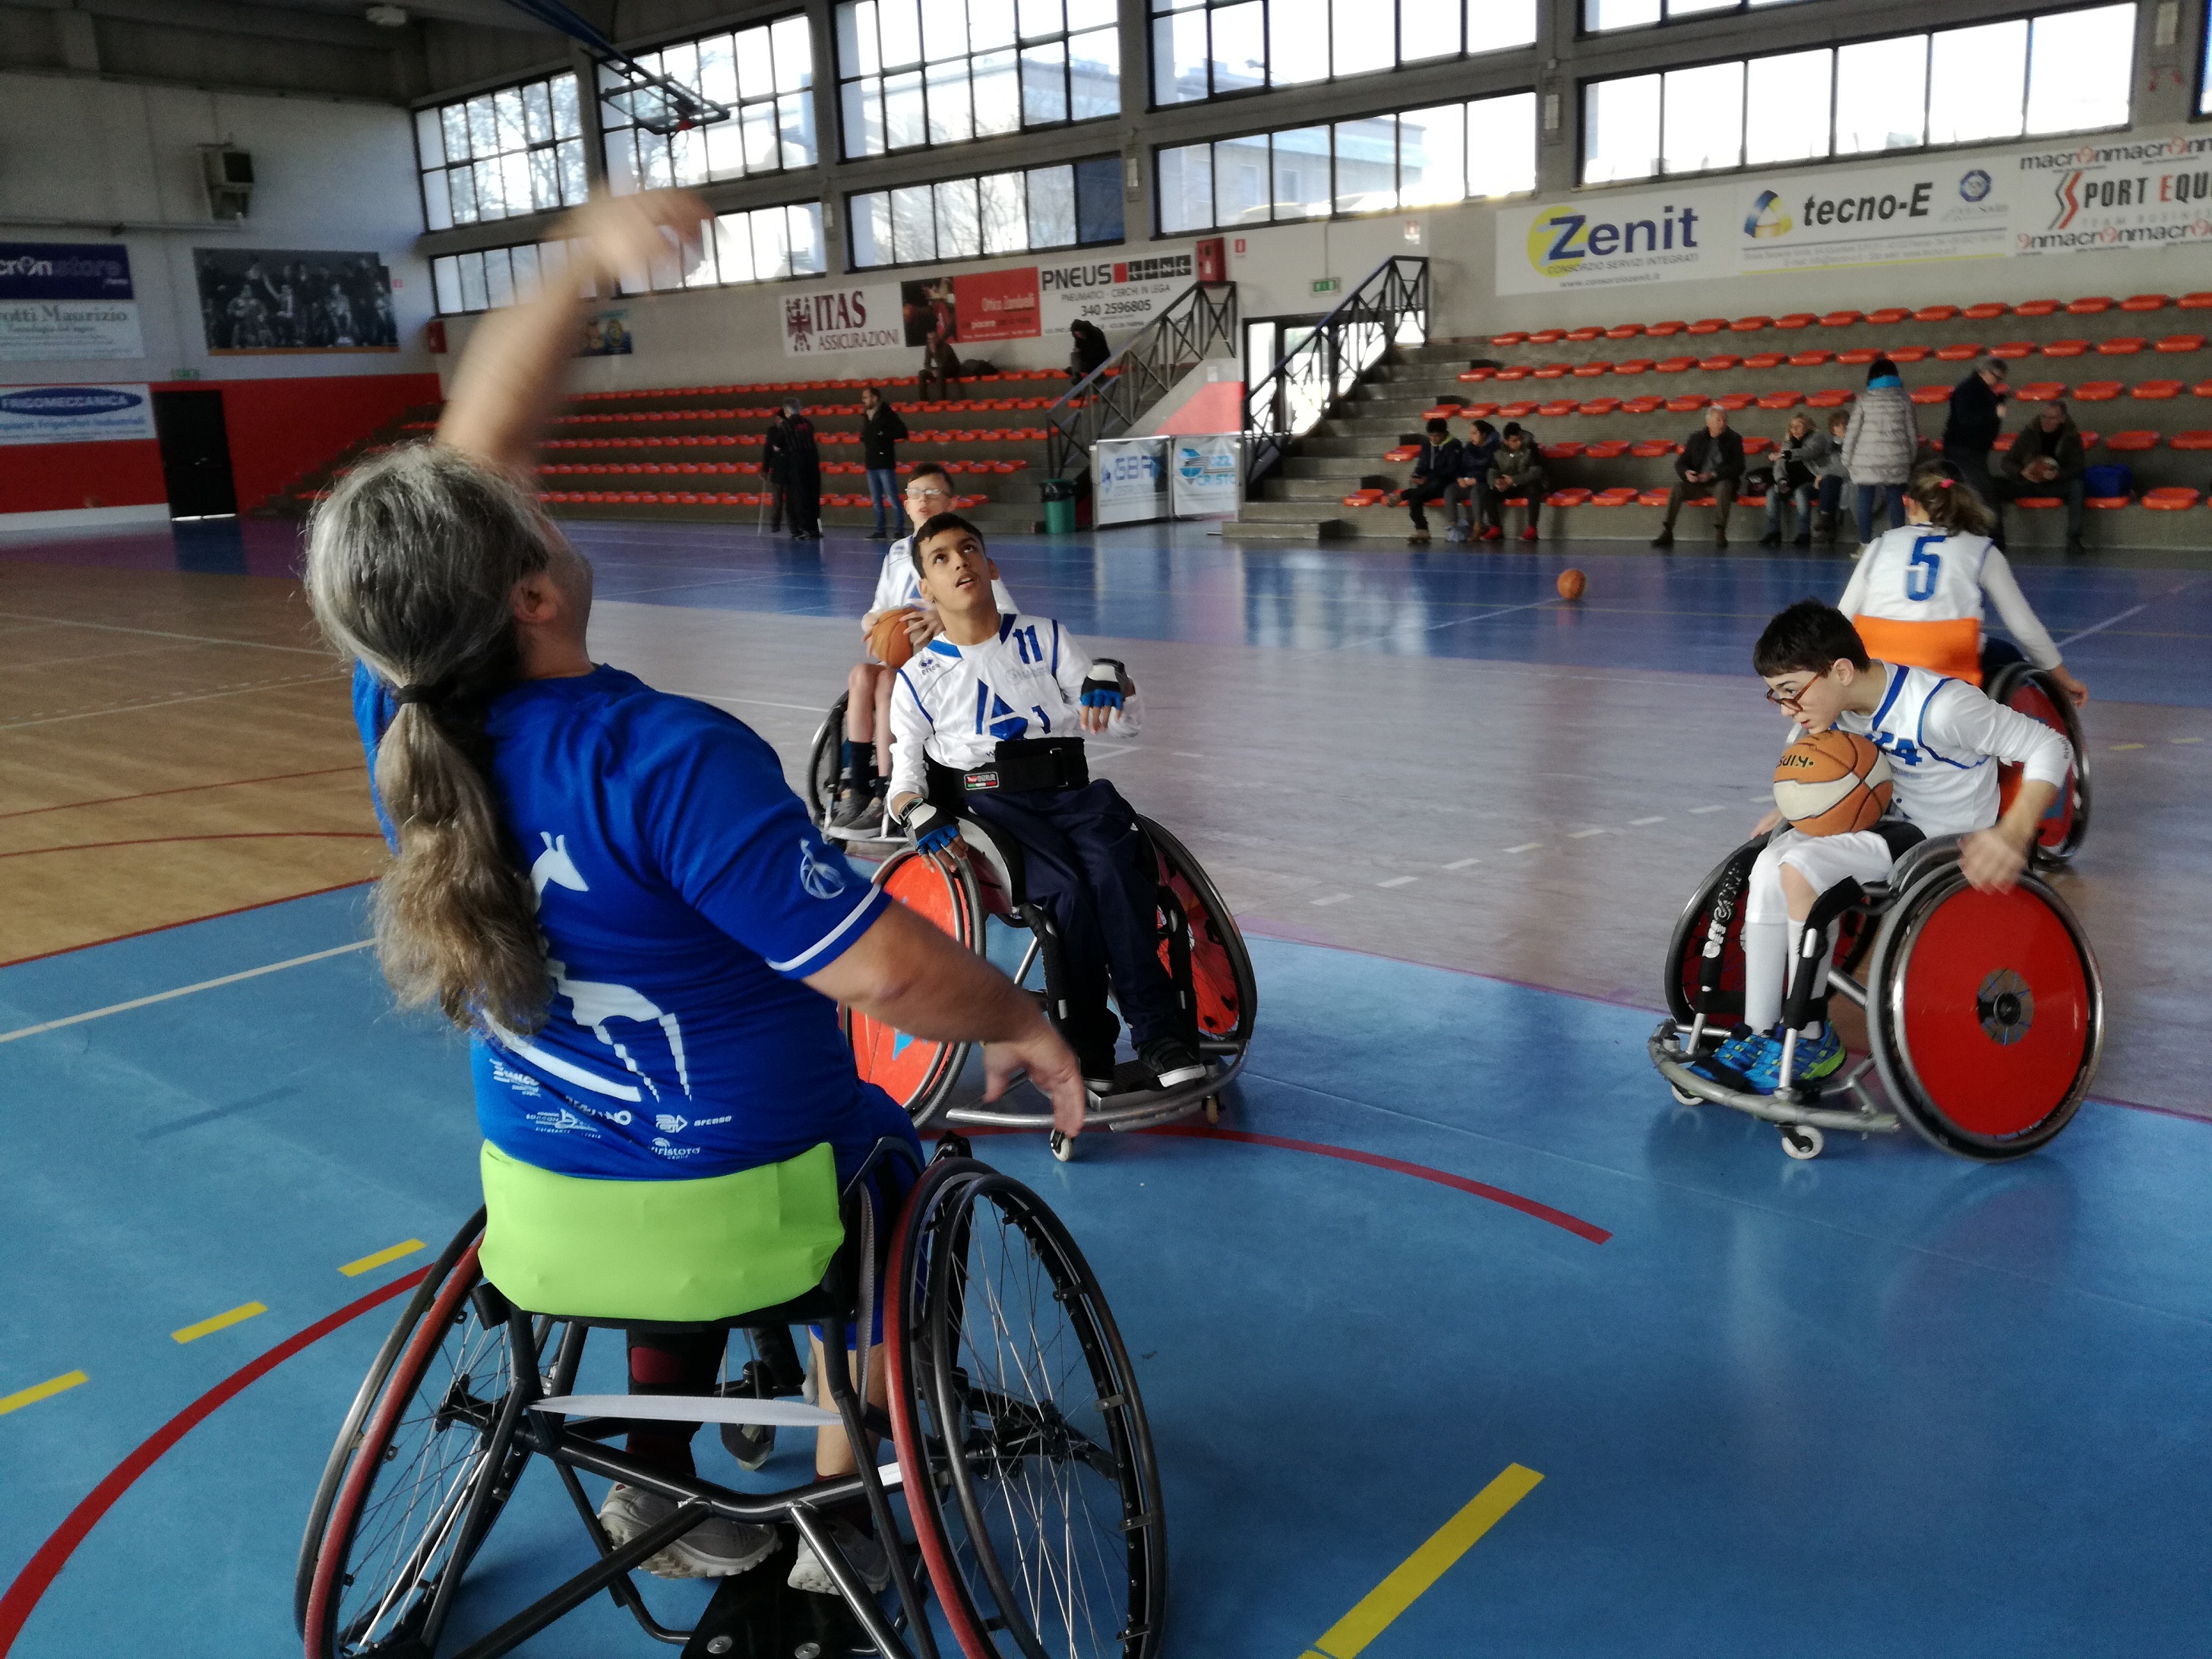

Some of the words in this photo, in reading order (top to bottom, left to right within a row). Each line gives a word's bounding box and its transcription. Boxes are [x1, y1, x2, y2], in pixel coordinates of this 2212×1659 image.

[2160, 171, 2212, 203] EQU
[1803, 182, 1933, 226] tecno-E
[1548, 206, 1698, 260] Zenit
[1041, 264, 1112, 291] PNEUS
[1547, 261, 1604, 274] CONSORZIO
[1606, 258, 1644, 270] SERVIZI
[1646, 253, 1699, 266] INTEGRATI
[1062, 290, 1104, 302] PNEUMATICI
[1111, 286, 1138, 298] CERCHI
[1141, 286, 1149, 294] IN
[1151, 283, 1171, 293] LEGA
[1081, 305, 1101, 316] 340
[1104, 299, 1152, 314] 2596805
[814, 291, 867, 331] ITAS
[818, 329, 900, 351] ASSICURAZIONI
[1907, 535, 1947, 601] 5
[1012, 625, 1043, 665] 11
